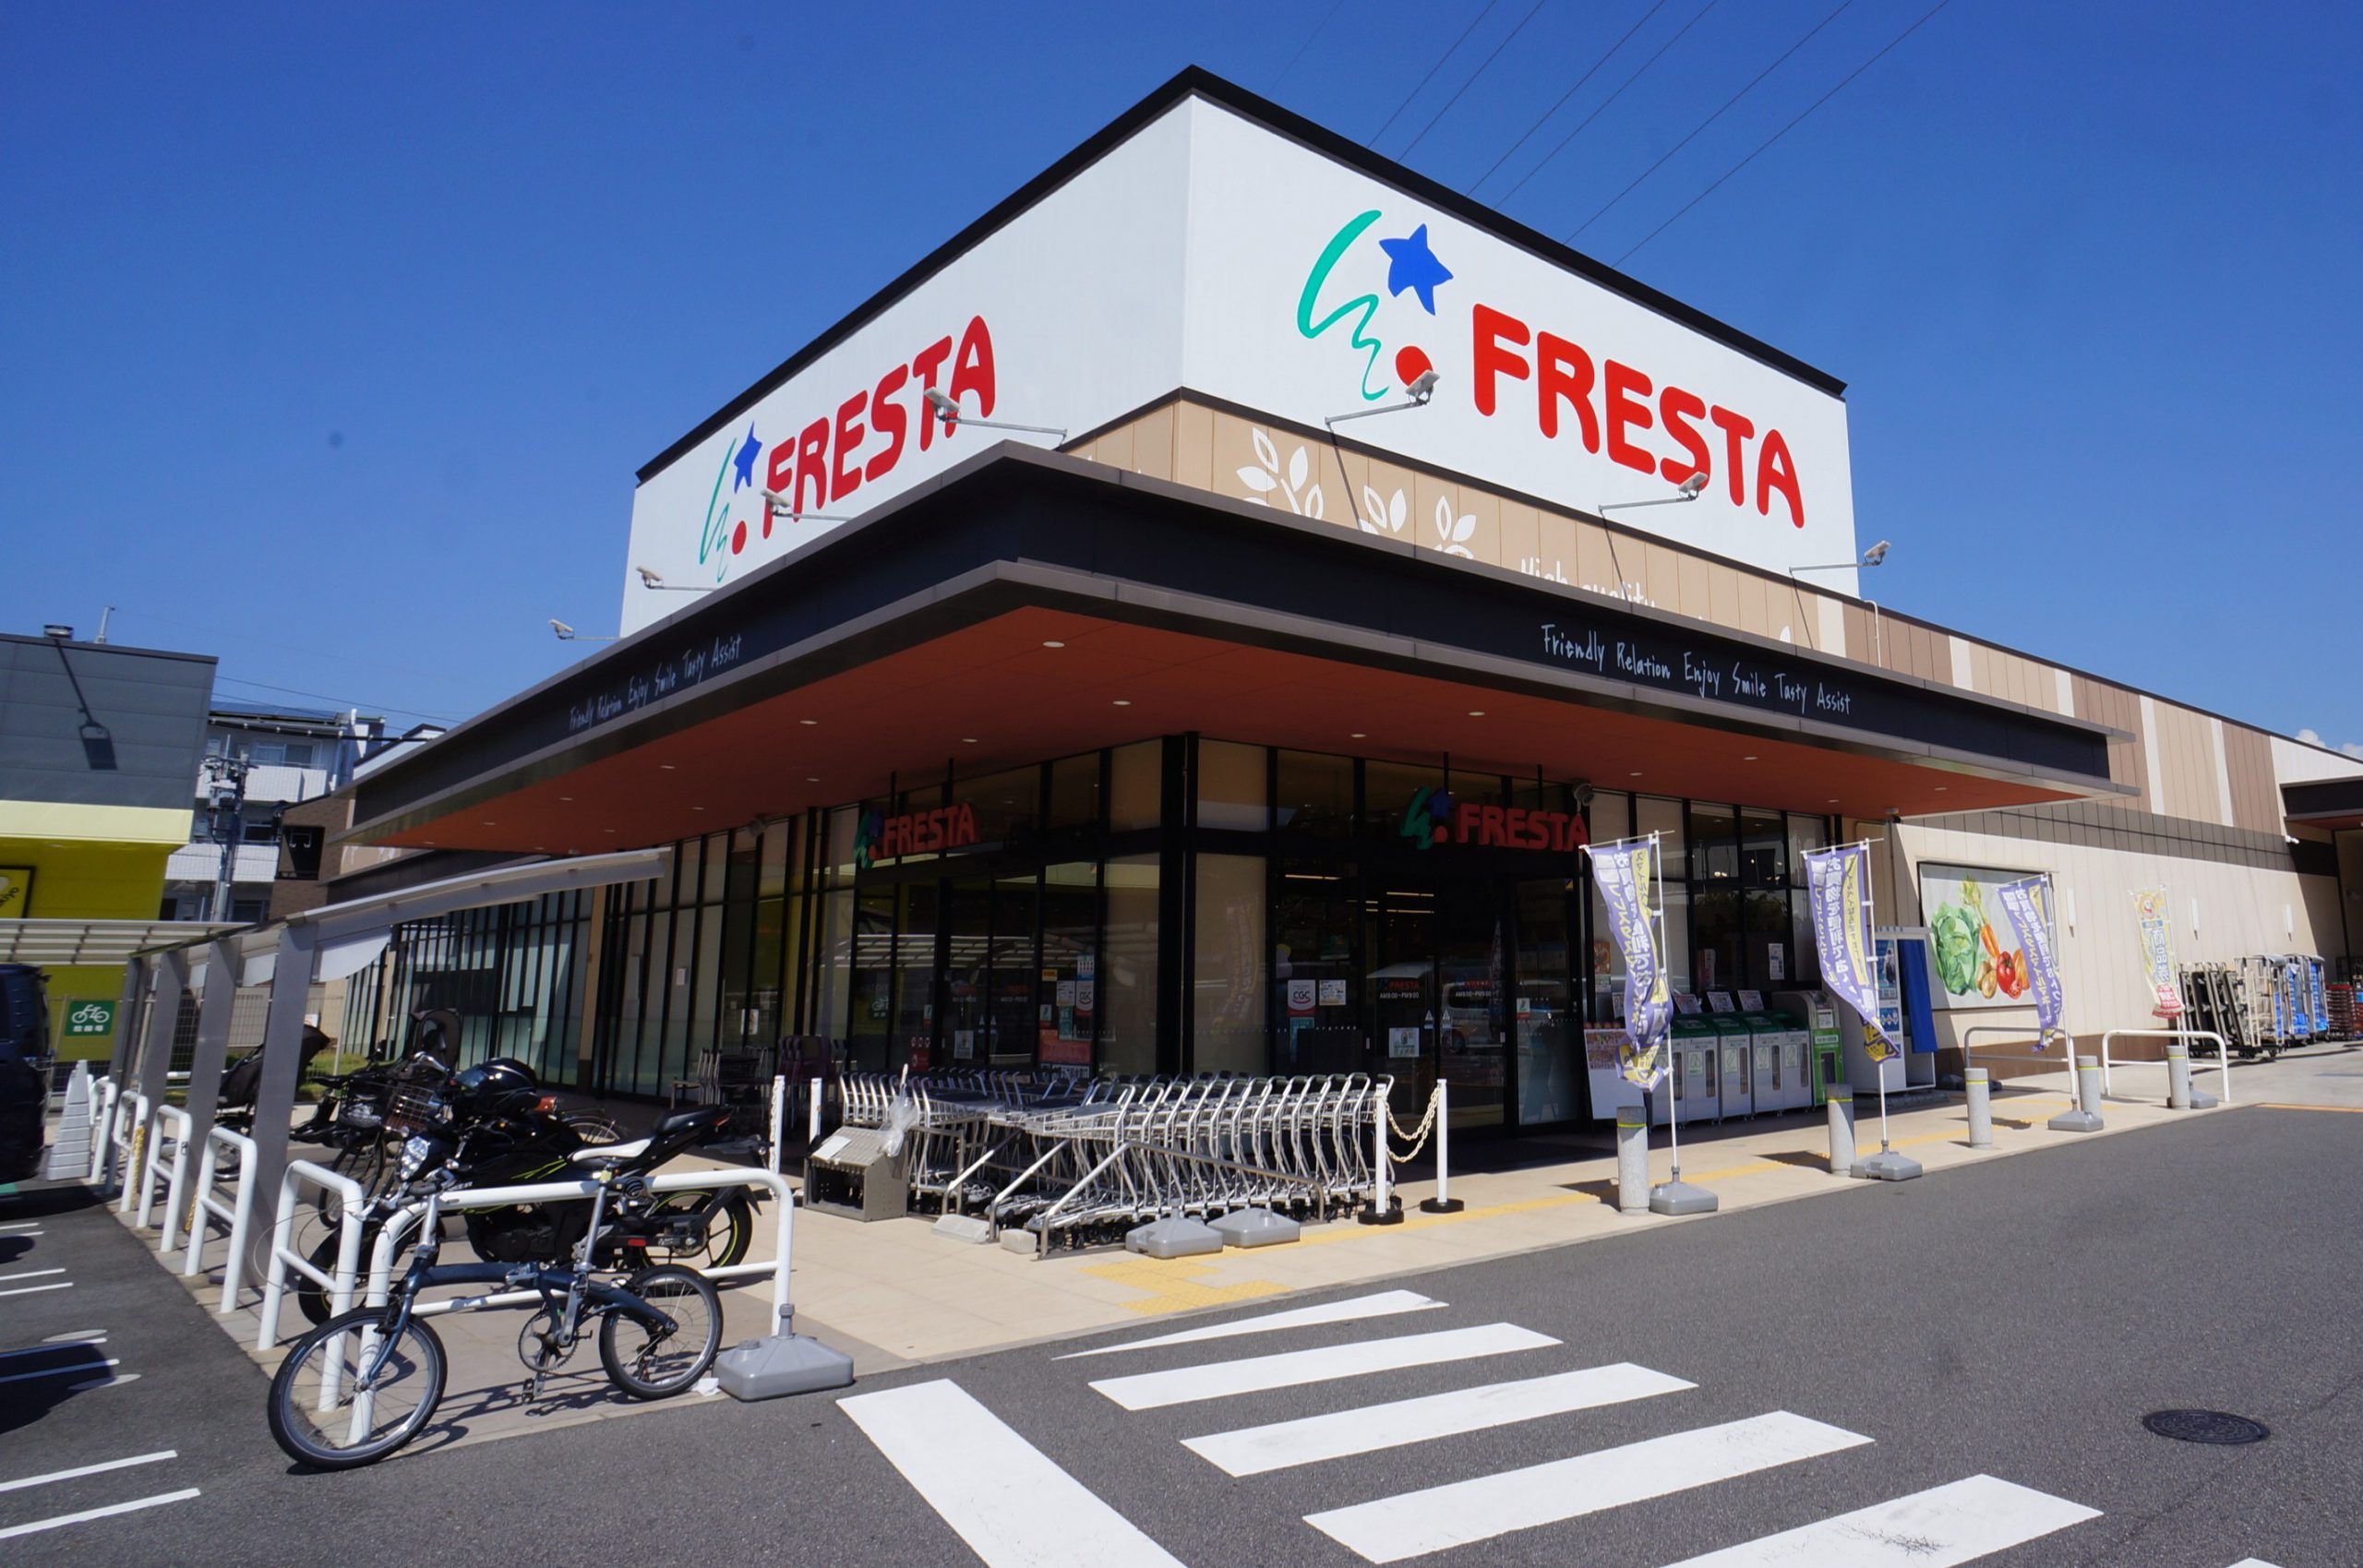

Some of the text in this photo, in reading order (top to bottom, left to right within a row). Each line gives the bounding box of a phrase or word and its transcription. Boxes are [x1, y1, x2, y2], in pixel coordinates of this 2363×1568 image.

[761, 315, 997, 540] FRESTA
[1471, 303, 1805, 530] FRESTA
[628, 676, 650, 709] Enjoy
[654, 662, 677, 697] Smile
[682, 649, 706, 684] Tasty
[711, 634, 742, 667] Assist
[1541, 624, 1851, 715] Friendly Relation Enjoy Smile Tasty Assist
[882, 803, 978, 856] FRESTA
[1459, 804, 1589, 852] FRESTA
[1292, 989, 1311, 999] CGC
